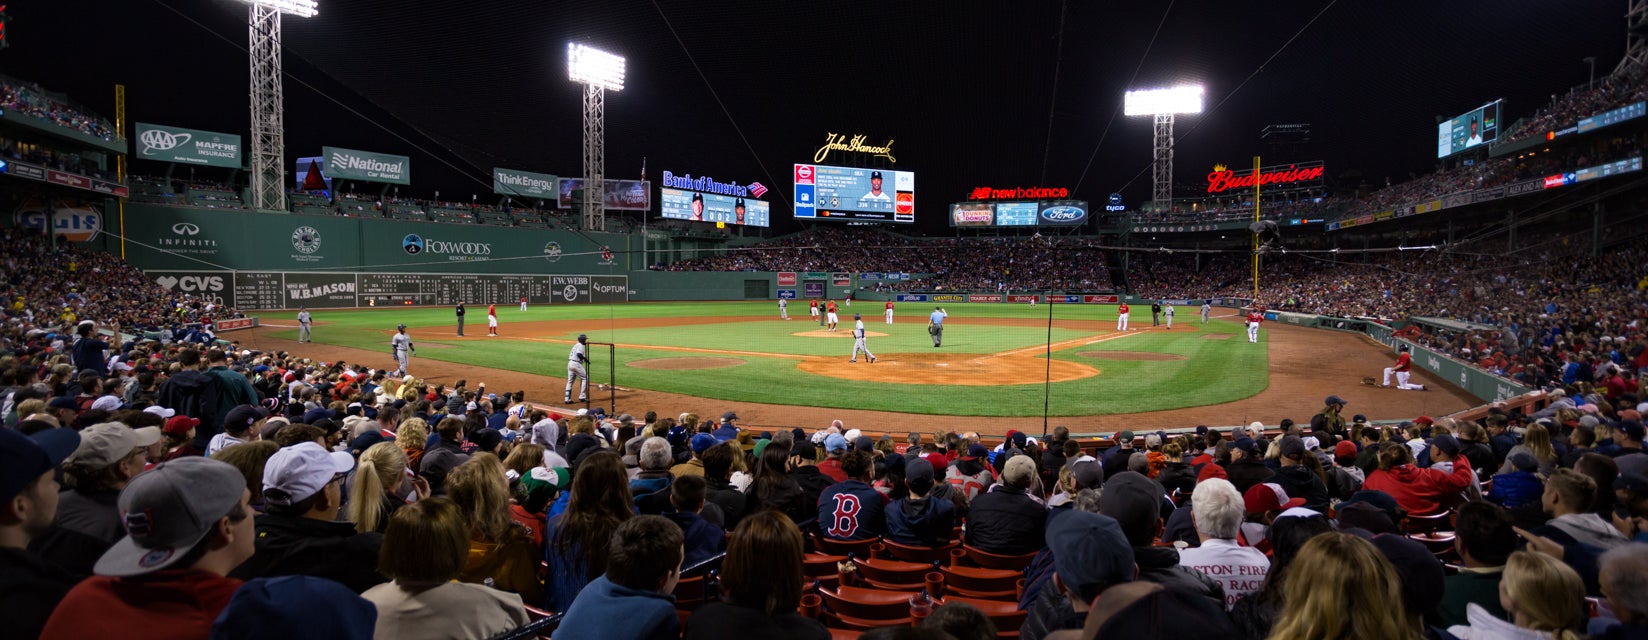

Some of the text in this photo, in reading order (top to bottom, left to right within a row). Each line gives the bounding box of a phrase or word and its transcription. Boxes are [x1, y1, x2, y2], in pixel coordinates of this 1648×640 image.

[141, 129, 177, 150] AAA
[195, 140, 238, 152] MAPFRE
[814, 132, 897, 163] John Hancock
[198, 149, 235, 159] INSURANCE
[348, 156, 403, 173] National
[663, 170, 747, 197] Bank of America
[1207, 164, 1325, 193] Budweiser
[991, 186, 1068, 199] new balance
[21, 211, 97, 230] Gulf
[1050, 208, 1076, 220] Ford
[159, 237, 216, 247] INFINITI
[178, 275, 224, 291] CVS
[600, 285, 625, 293] OPTUM
[827, 492, 862, 538] B
[1193, 564, 1267, 577] STON FIRE
